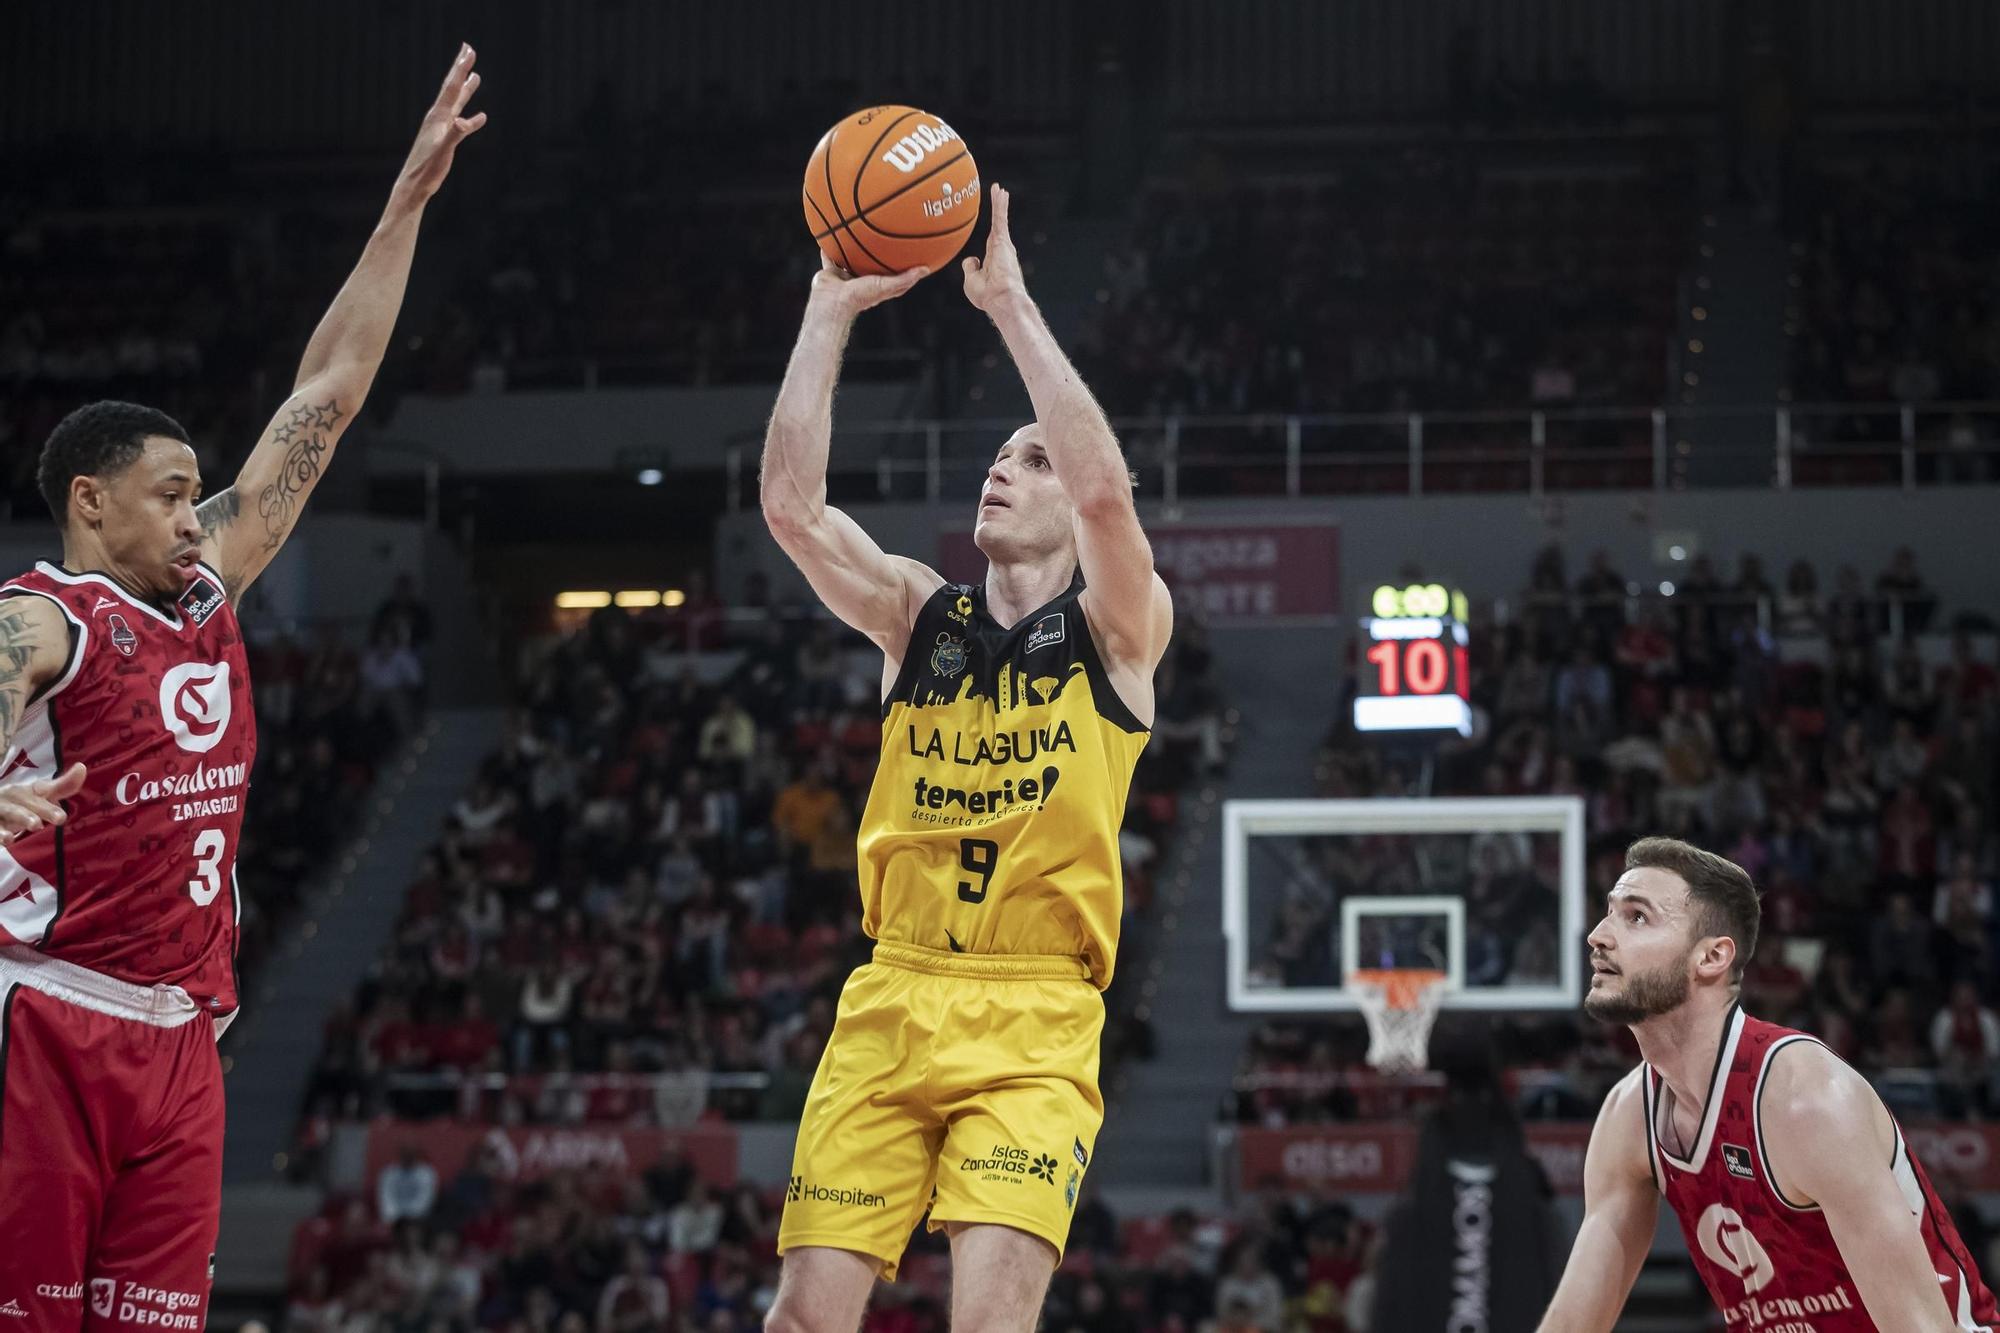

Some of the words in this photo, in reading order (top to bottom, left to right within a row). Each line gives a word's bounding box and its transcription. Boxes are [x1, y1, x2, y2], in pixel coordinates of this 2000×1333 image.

[1367, 638, 1449, 697] 10
[909, 724, 946, 761] LA
[116, 761, 247, 806] Casademo
[911, 808, 972, 827] despierta
[189, 828, 226, 907] 3
[957, 837, 999, 904] 9
[960, 1156, 1026, 1174] Canarias
[991, 1144, 1029, 1161] Islas
[804, 1183, 886, 1209] Hospiten
